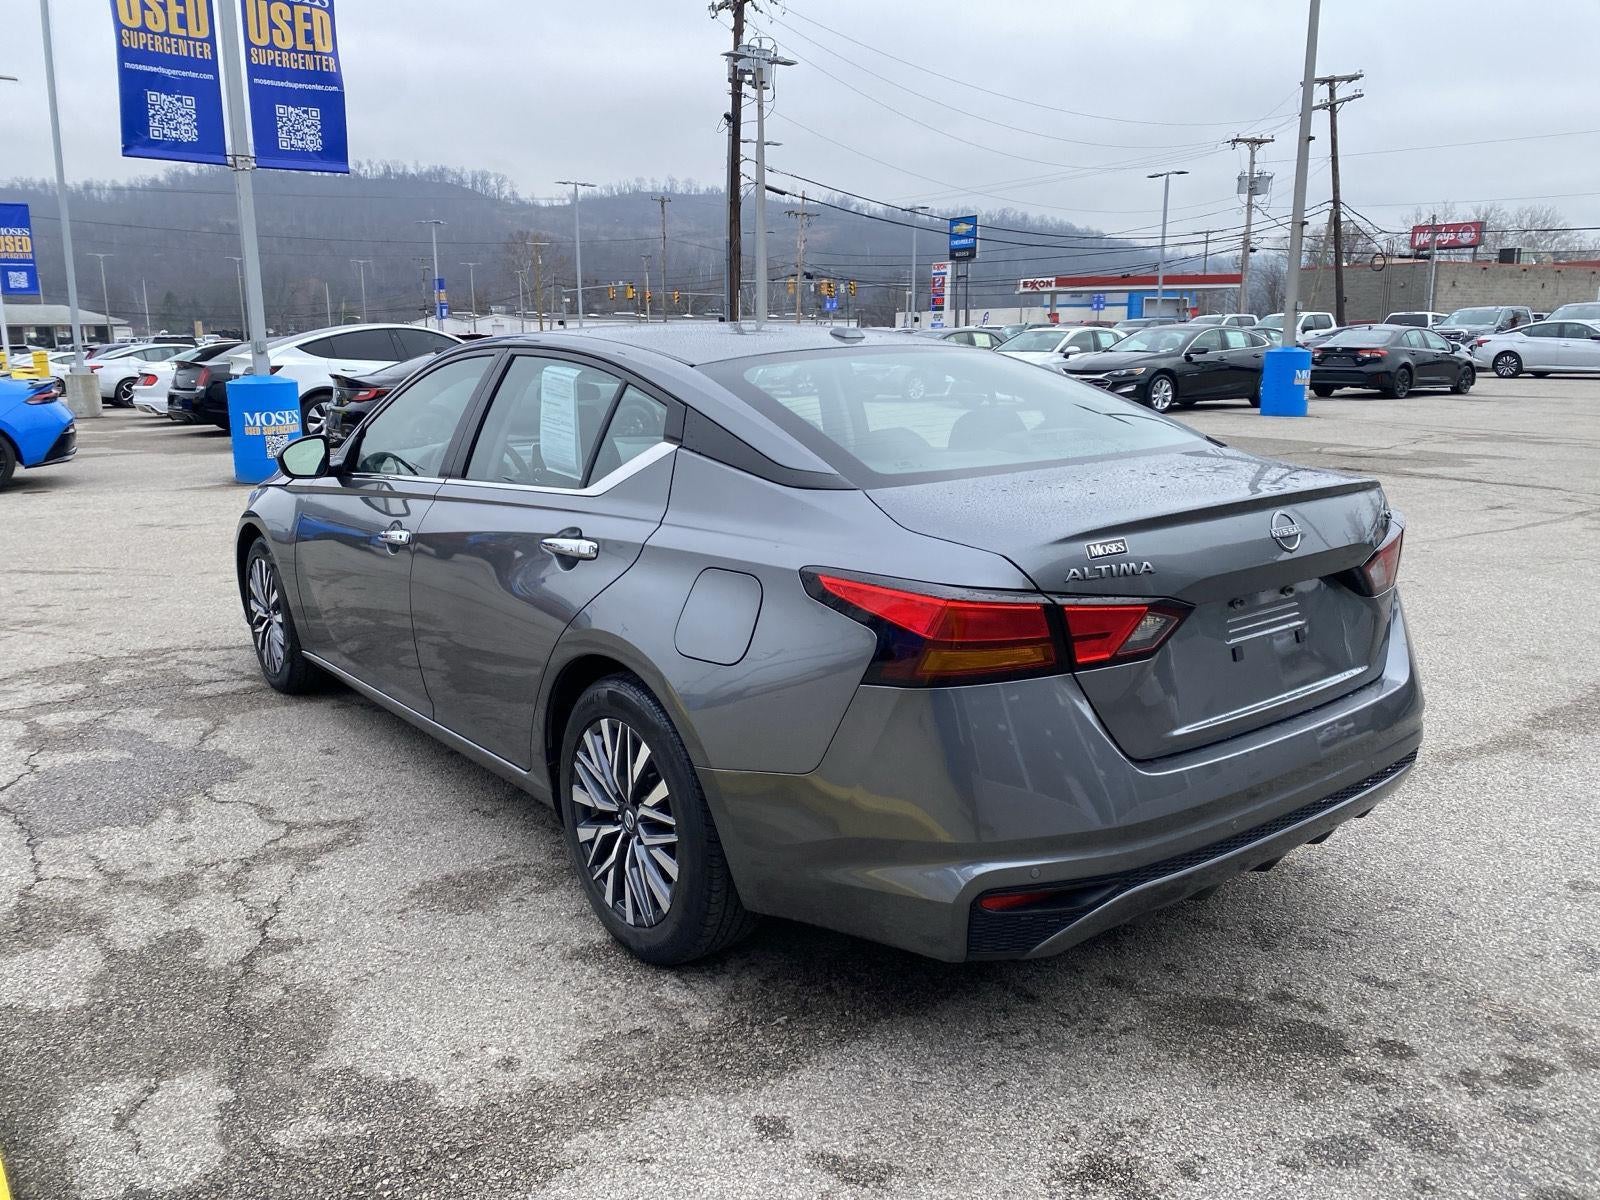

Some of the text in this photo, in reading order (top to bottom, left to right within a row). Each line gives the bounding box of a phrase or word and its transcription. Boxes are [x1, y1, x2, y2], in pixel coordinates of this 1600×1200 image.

[117, 0, 210, 39] USED
[245, 0, 333, 53] USED
[121, 28, 212, 60] SUPERCENTER
[251, 47, 337, 73] SUPERCENTER
[124, 62, 214, 80] mosesusedsupercenter.com
[253, 77, 339, 92] mosesusedsupercenter.com
[1022, 279, 1053, 290] EXXON
[243, 409, 299, 427] MOSES
[1089, 541, 1126, 557] MOSES
[1065, 561, 1156, 583] ALTIMA
